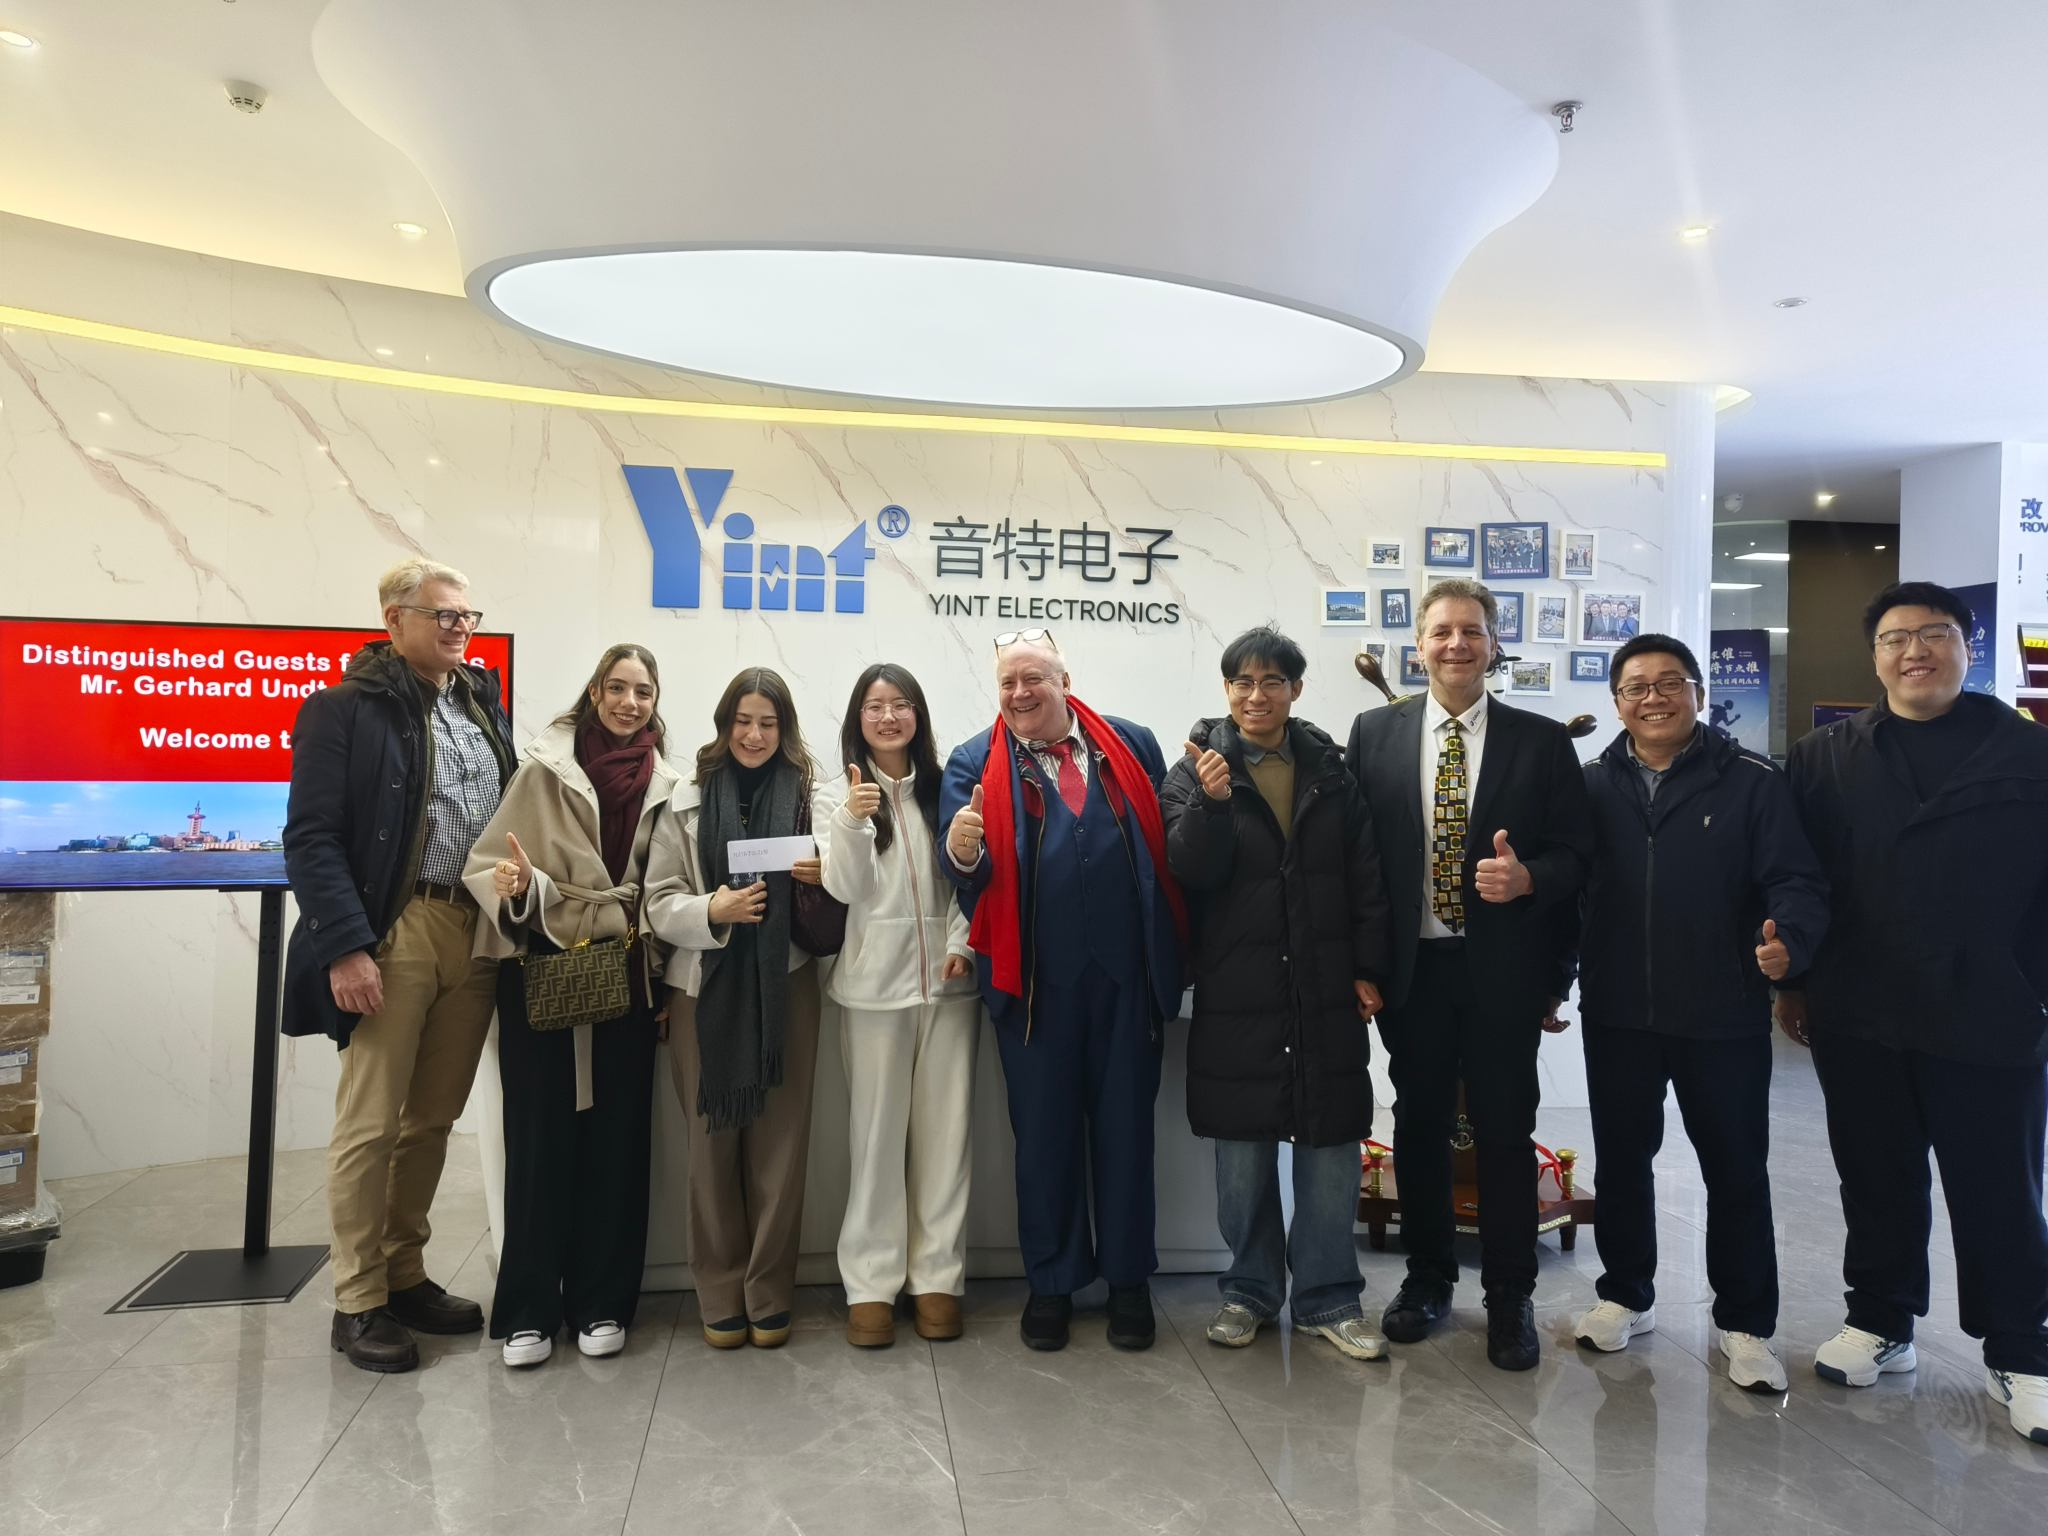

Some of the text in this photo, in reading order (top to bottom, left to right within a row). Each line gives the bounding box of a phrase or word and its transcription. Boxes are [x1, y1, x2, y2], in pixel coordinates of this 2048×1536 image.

[621, 464, 876, 614] Yint
[929, 515, 1180, 586] 音特电子
[928, 593, 1181, 625] YINT ELECTRONICS
[22, 643, 225, 671] Distinguished
[234, 649, 331, 672] Guests
[80, 674, 123, 695] Mr.
[133, 675, 252, 698] Gerhard
[139, 727, 271, 749] Welcome
